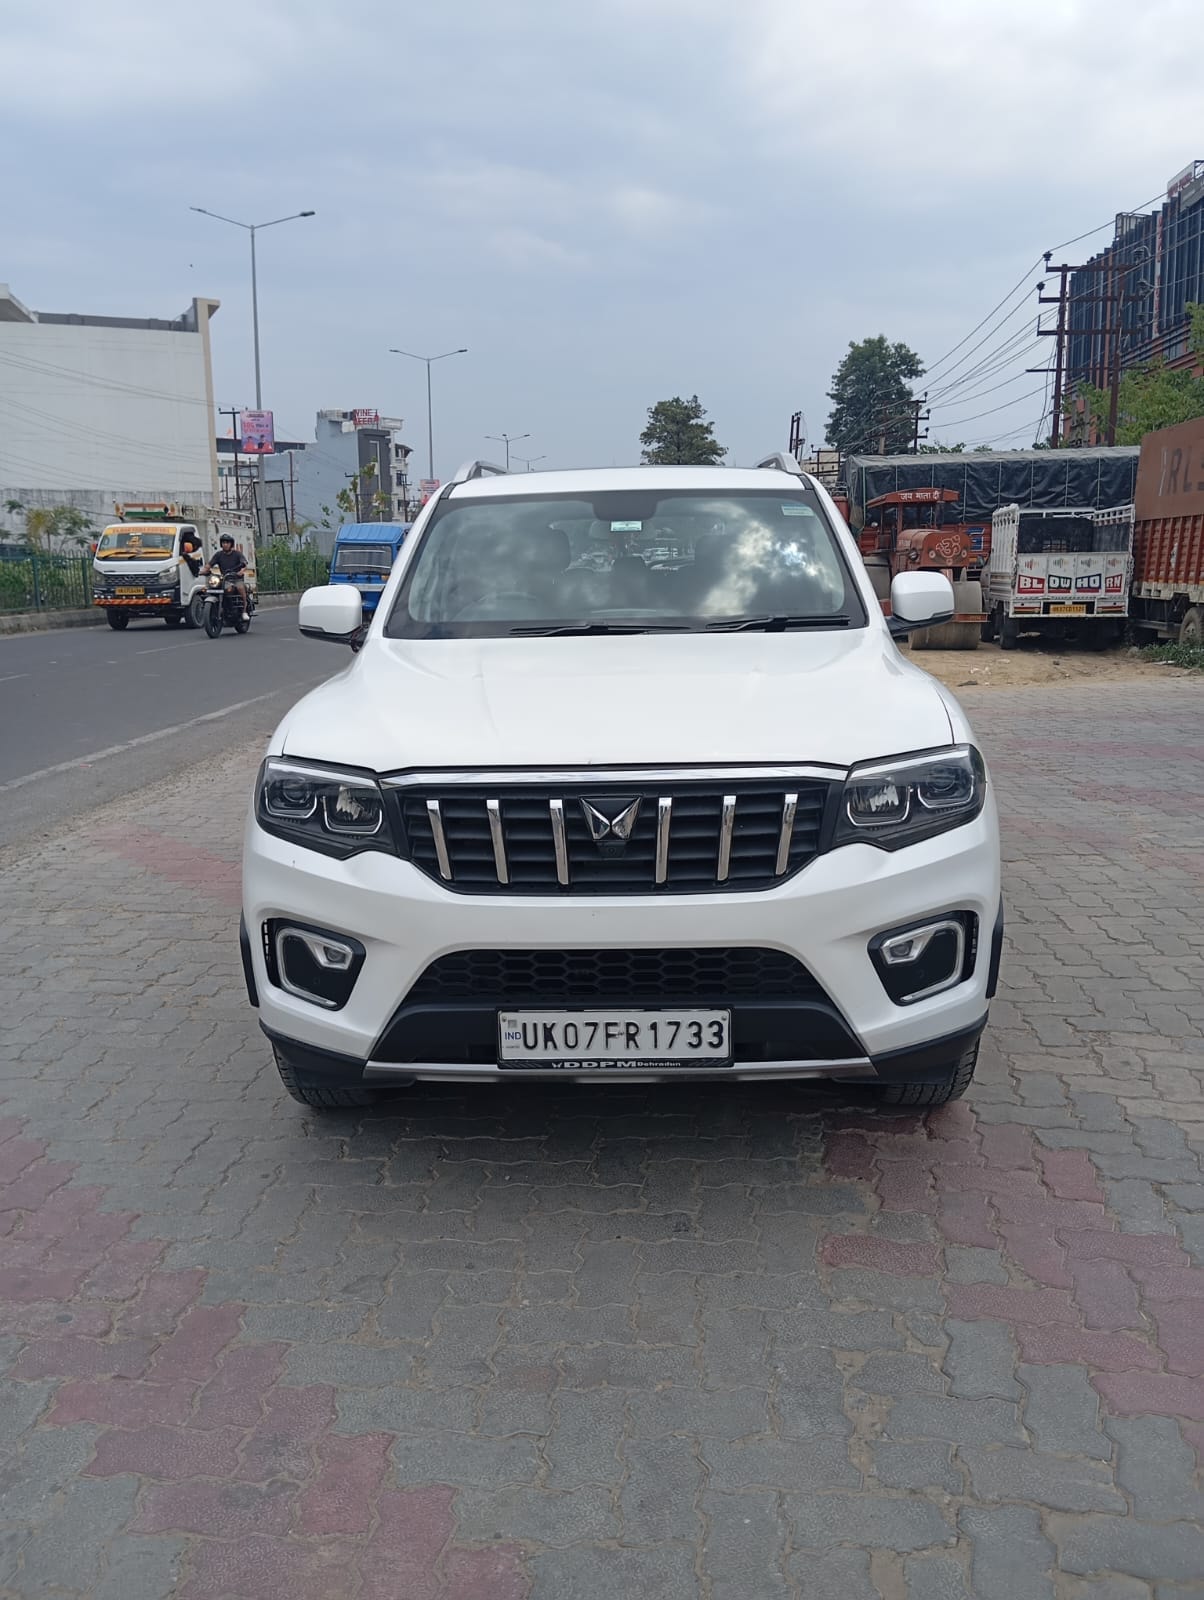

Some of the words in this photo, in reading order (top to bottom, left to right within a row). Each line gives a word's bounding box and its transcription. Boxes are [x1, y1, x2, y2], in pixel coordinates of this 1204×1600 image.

[898, 492, 913, 500] जय
[915, 492, 931, 500] माता
[504, 1031, 521, 1040] IND
[521, 1021, 724, 1050] UK07FR1733
